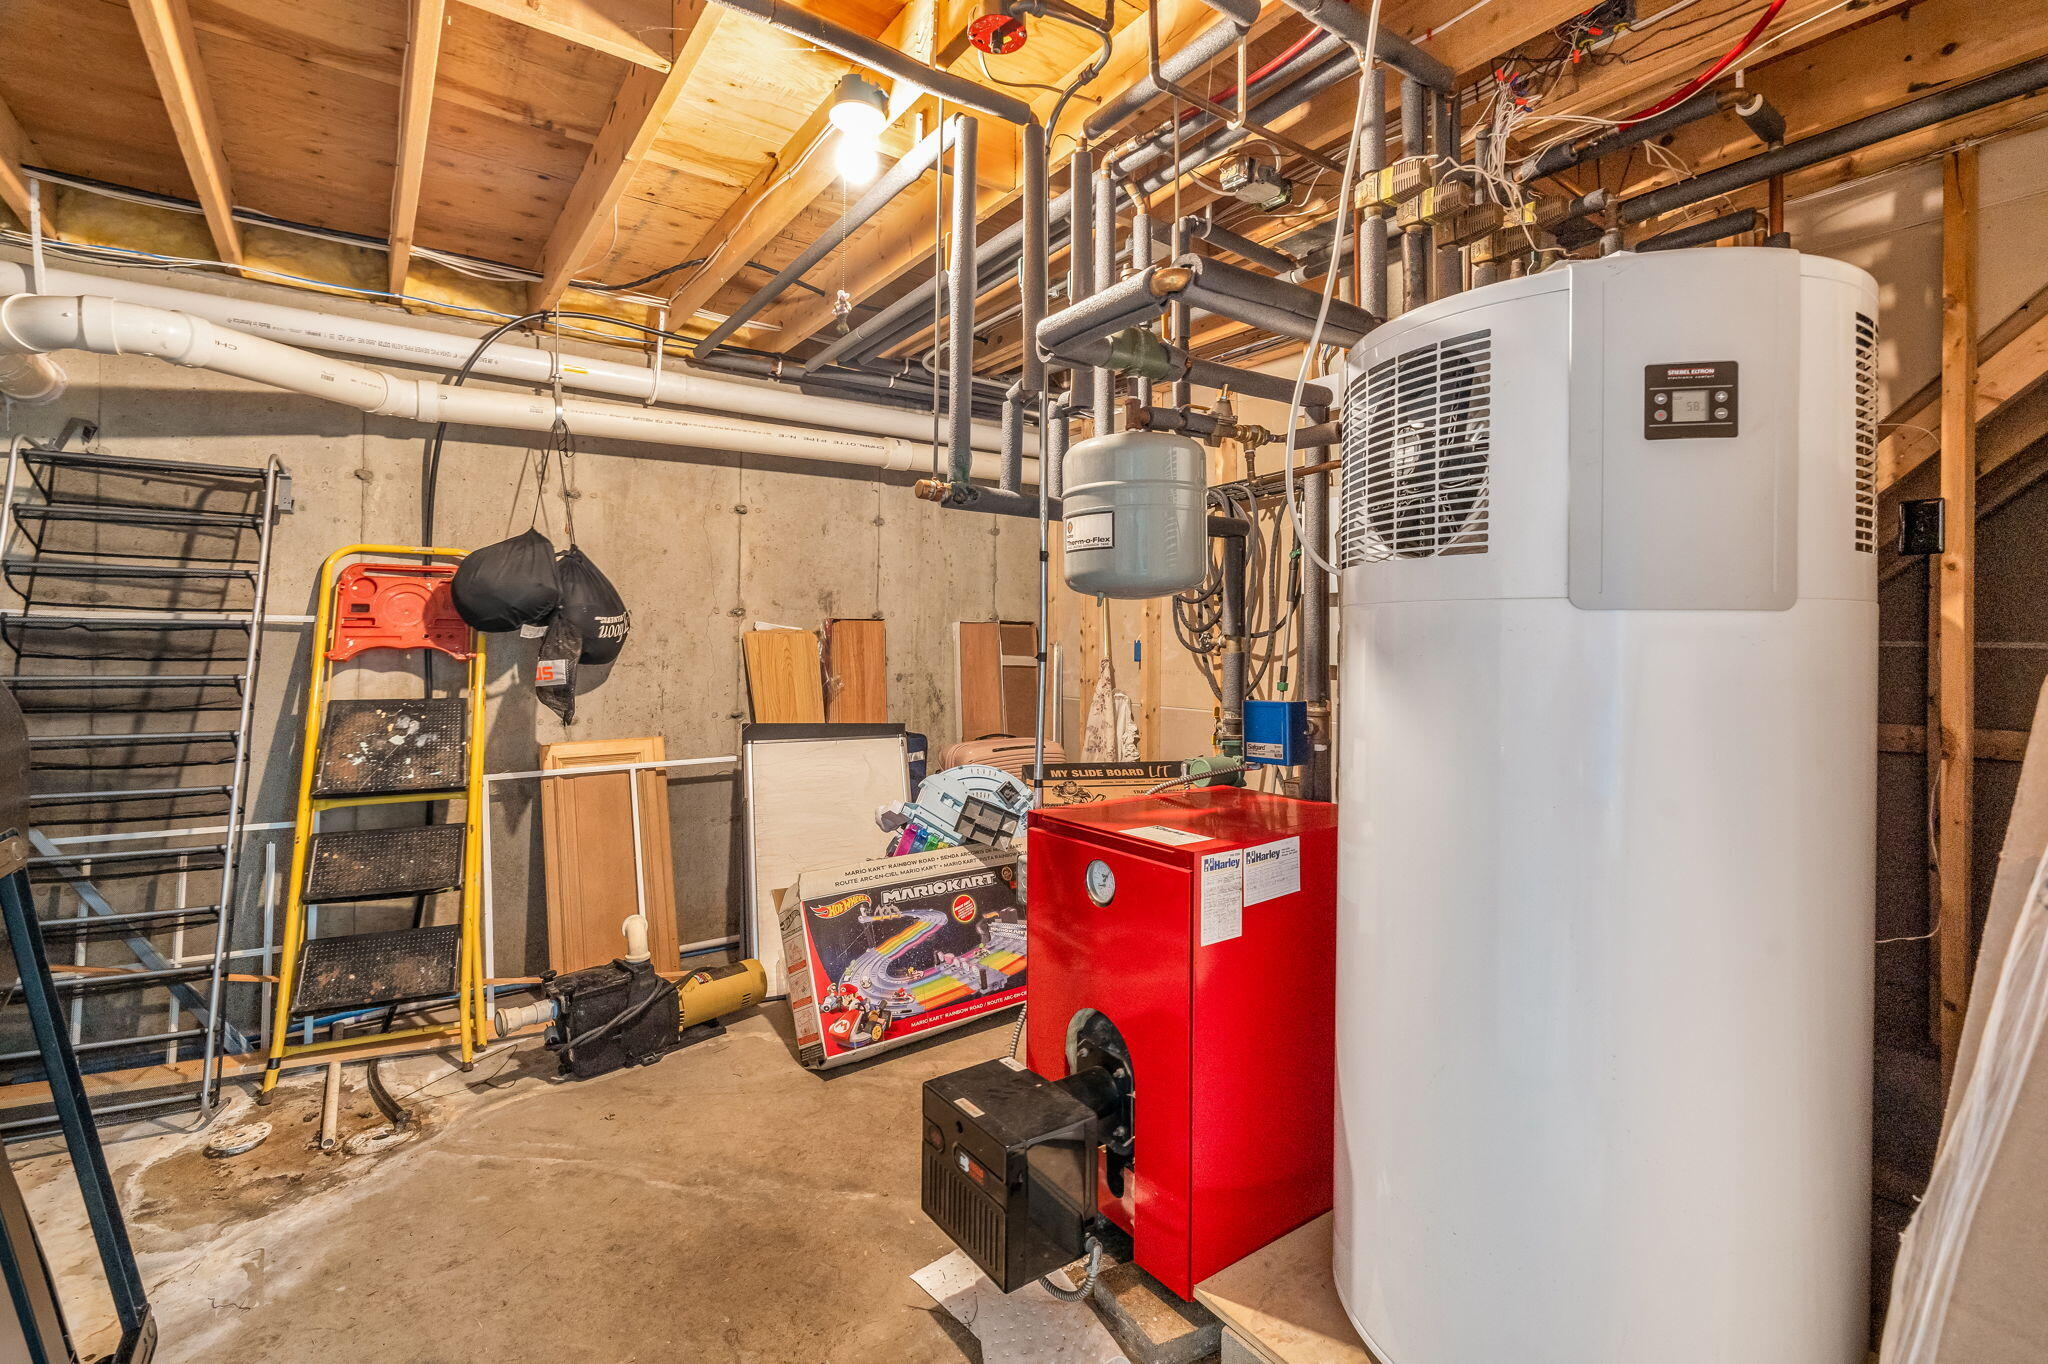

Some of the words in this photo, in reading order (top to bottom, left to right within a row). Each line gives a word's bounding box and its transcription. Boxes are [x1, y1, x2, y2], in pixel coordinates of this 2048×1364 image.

[1050, 769, 1068, 778] MY
[1071, 769, 1102, 777] SLIDE
[1105, 768, 1144, 777] BOARD
[1256, 849, 1280, 863] Harley
[845, 869, 867, 877] MARIO
[889, 860, 918, 869] RAINBOW
[940, 853, 959, 861] SENDA
[1214, 858, 1240, 870] Harley
[835, 878, 858, 887] ROUTE
[860, 872, 897, 883] ARC-EN-CIEL
[900, 867, 920, 875] MARIO
[828, 903, 844, 917] HOT
[911, 1018, 929, 1027] MARIO
[945, 1008, 969, 1018] RAINBOW
[970, 1003, 983, 1011] ROAD
[987, 998, 1003, 1006] ROUTE
